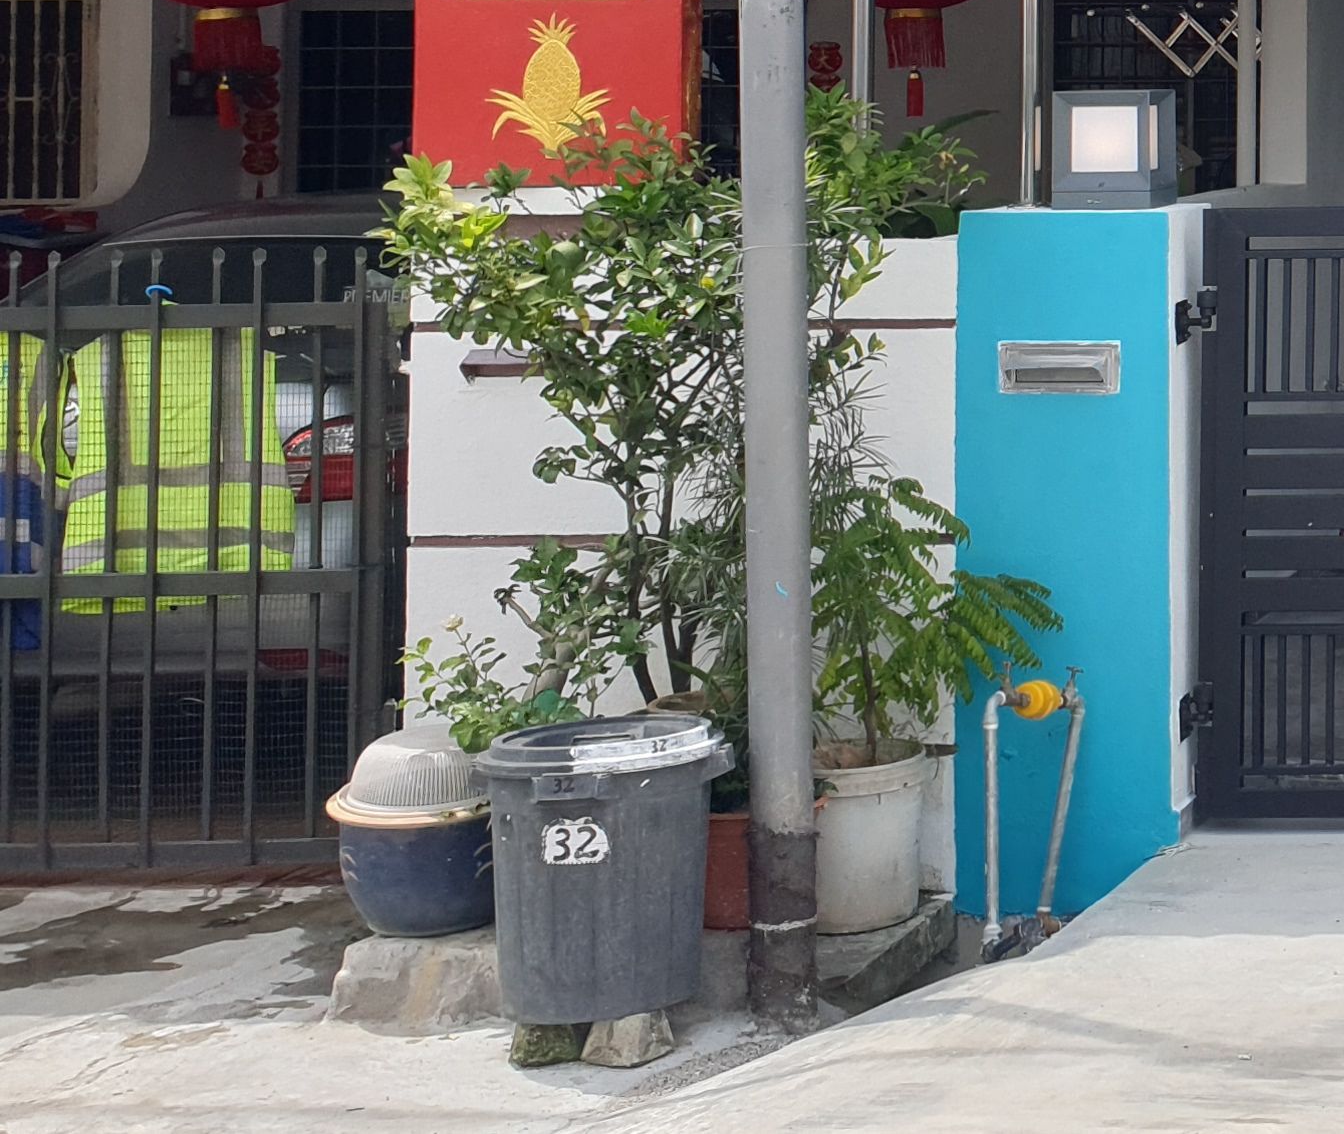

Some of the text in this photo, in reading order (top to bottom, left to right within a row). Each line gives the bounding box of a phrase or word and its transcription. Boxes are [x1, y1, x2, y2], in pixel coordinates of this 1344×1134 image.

[651, 738, 668, 754] 32
[553, 777, 576, 794] 32
[553, 826, 600, 862] 32
